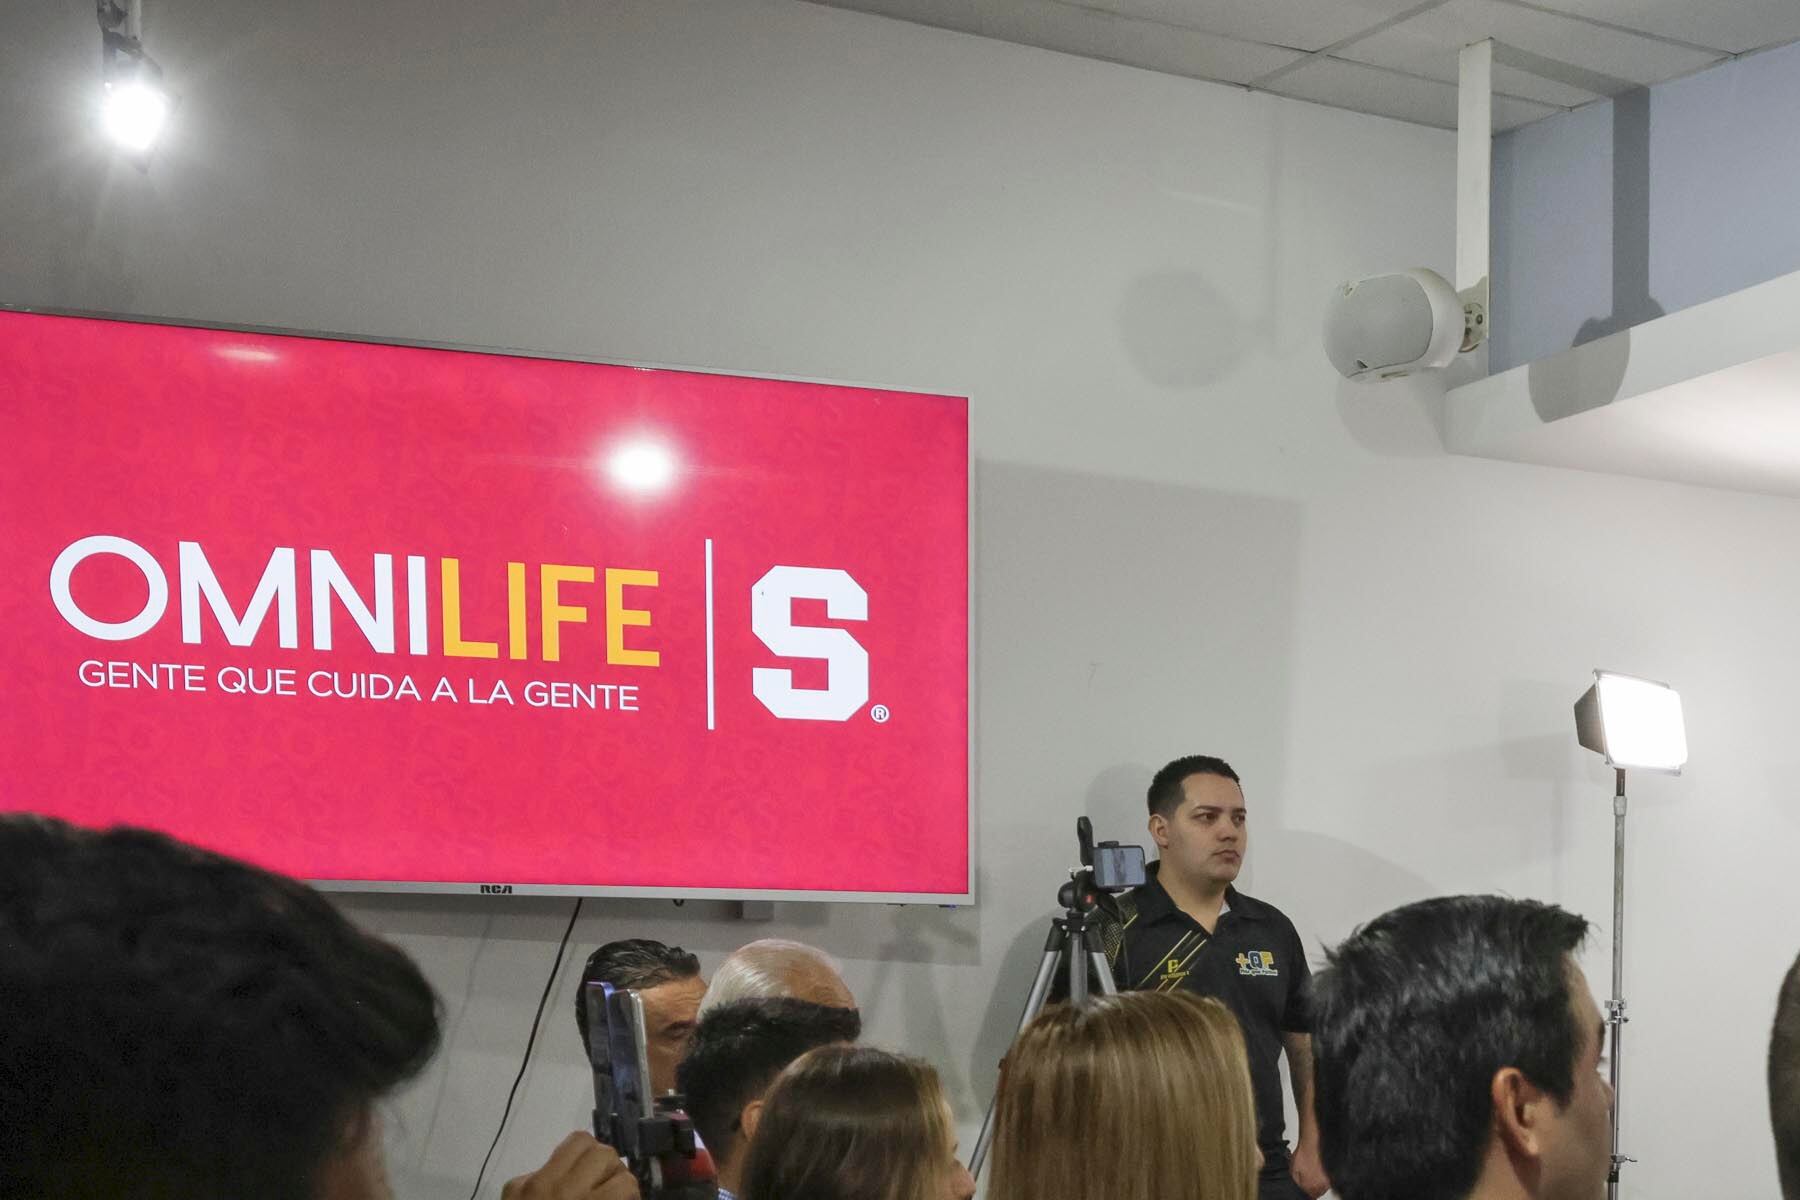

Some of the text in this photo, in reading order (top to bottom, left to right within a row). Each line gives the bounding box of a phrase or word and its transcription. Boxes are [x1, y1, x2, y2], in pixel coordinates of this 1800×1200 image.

[50, 535, 660, 667] OMNILIFE
[78, 659, 640, 711] GENTE QUE CUIDA A LA GENTE
[480, 884, 513, 895] RCA
